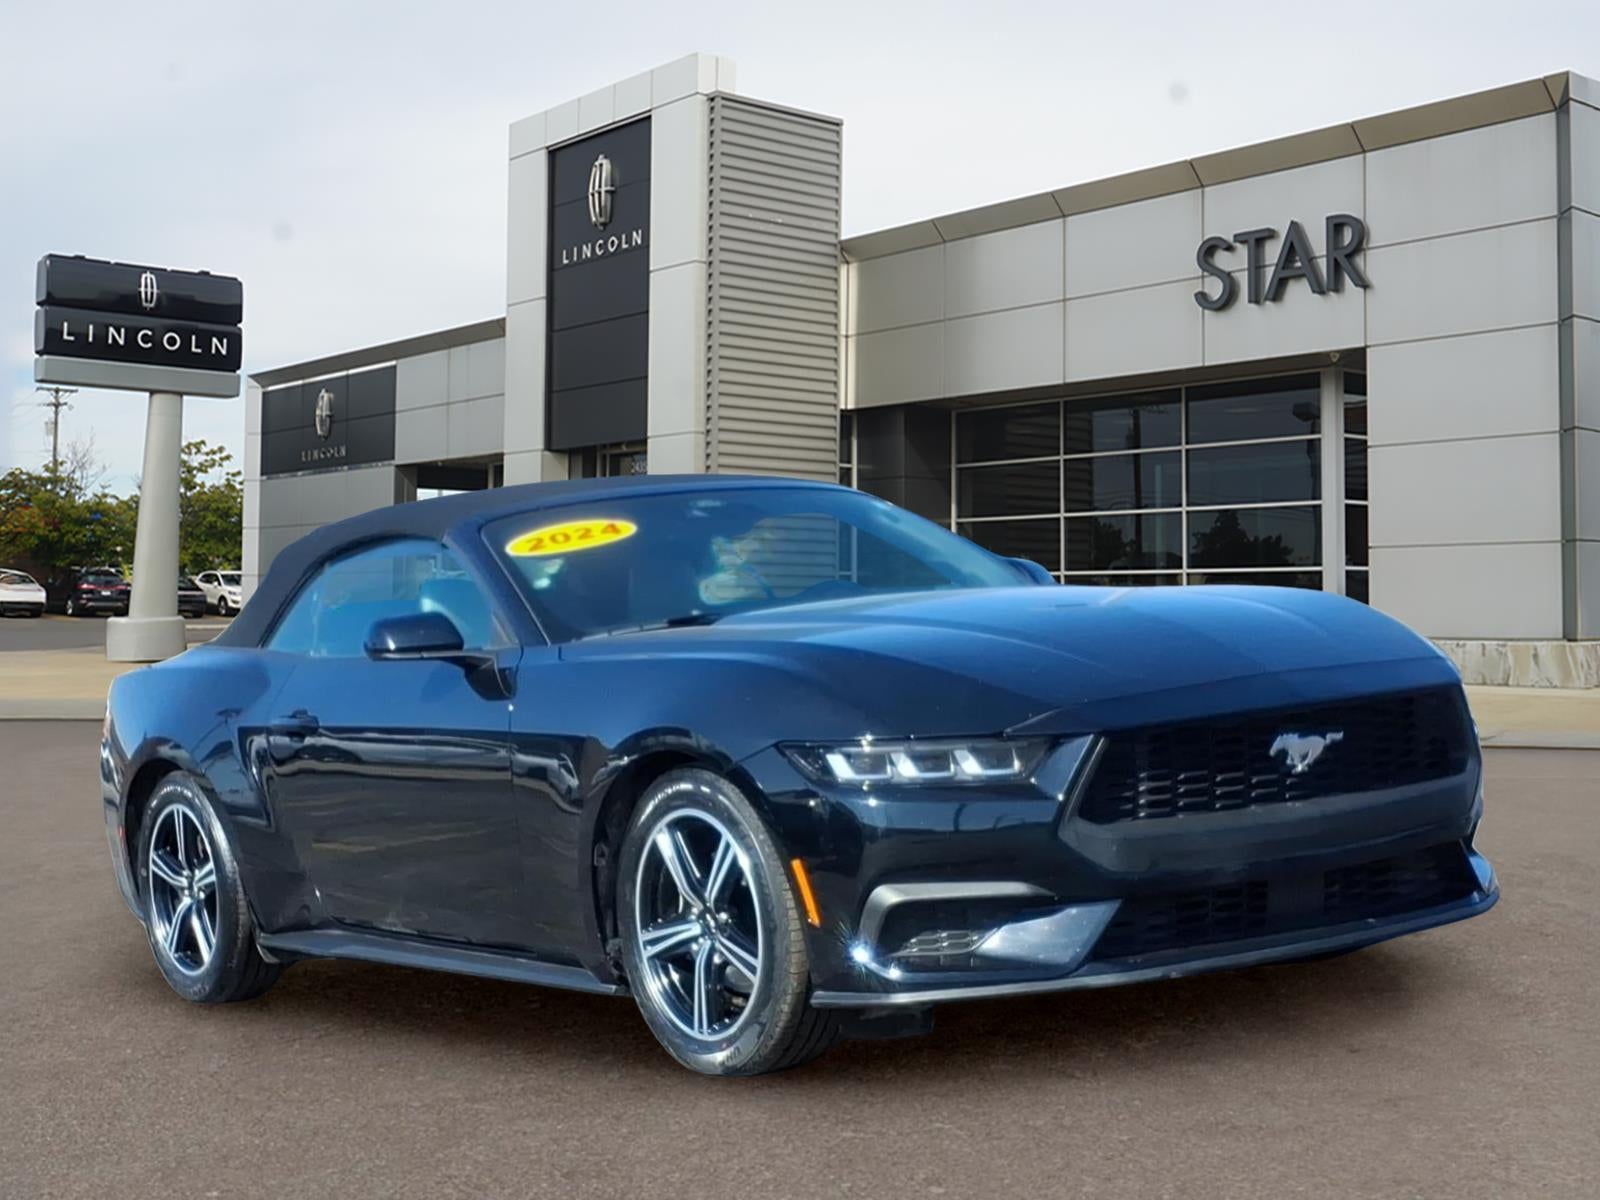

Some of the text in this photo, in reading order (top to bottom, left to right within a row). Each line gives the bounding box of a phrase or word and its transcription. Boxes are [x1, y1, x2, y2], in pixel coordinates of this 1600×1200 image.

[562, 229, 642, 265] LINCOLN
[1194, 213, 1370, 312] STAR
[62, 321, 228, 356] LINCOLN
[525, 523, 621, 553] 2024
